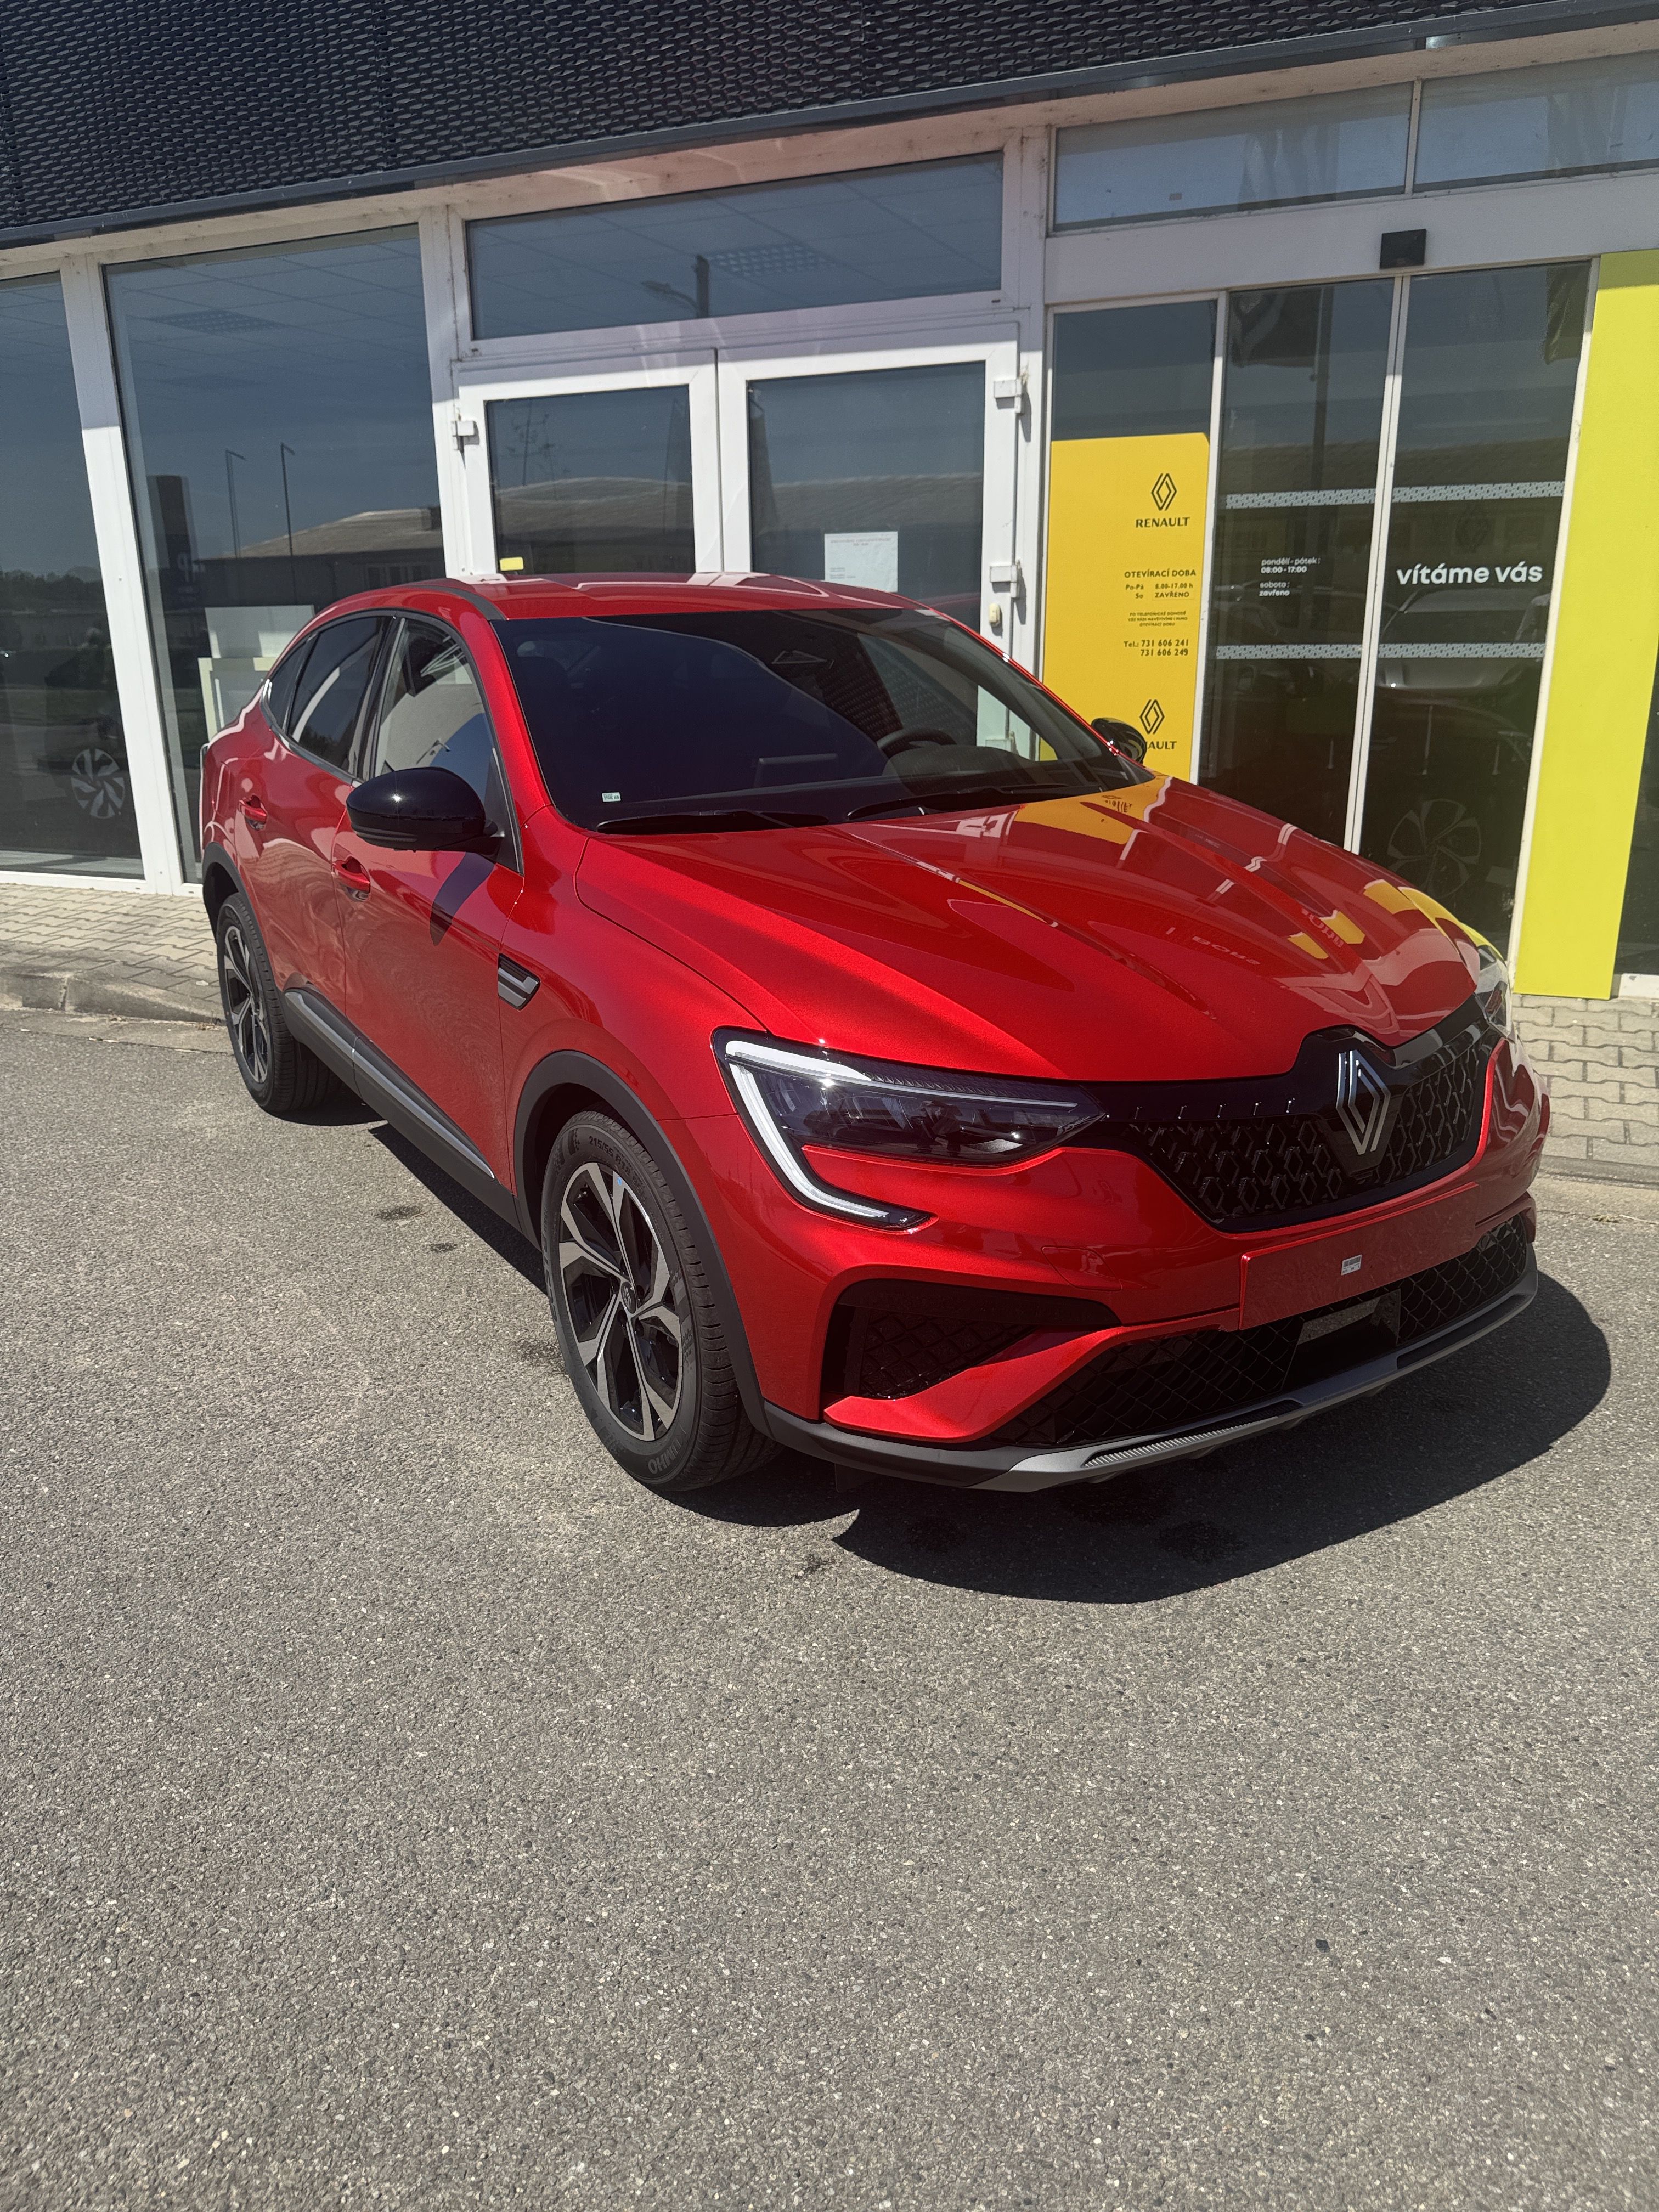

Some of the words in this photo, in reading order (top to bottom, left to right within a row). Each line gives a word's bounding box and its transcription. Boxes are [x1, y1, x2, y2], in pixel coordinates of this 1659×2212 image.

[1135, 517, 1190, 528] RENAULT
[1124, 568, 1170, 578] OTEVÍRACÍ
[1396, 563, 1489, 585] vítáme
[1495, 561, 1542, 583] vás
[1146, 741, 1177, 749] AULT
[588, 1136, 614, 1158] 215/55
